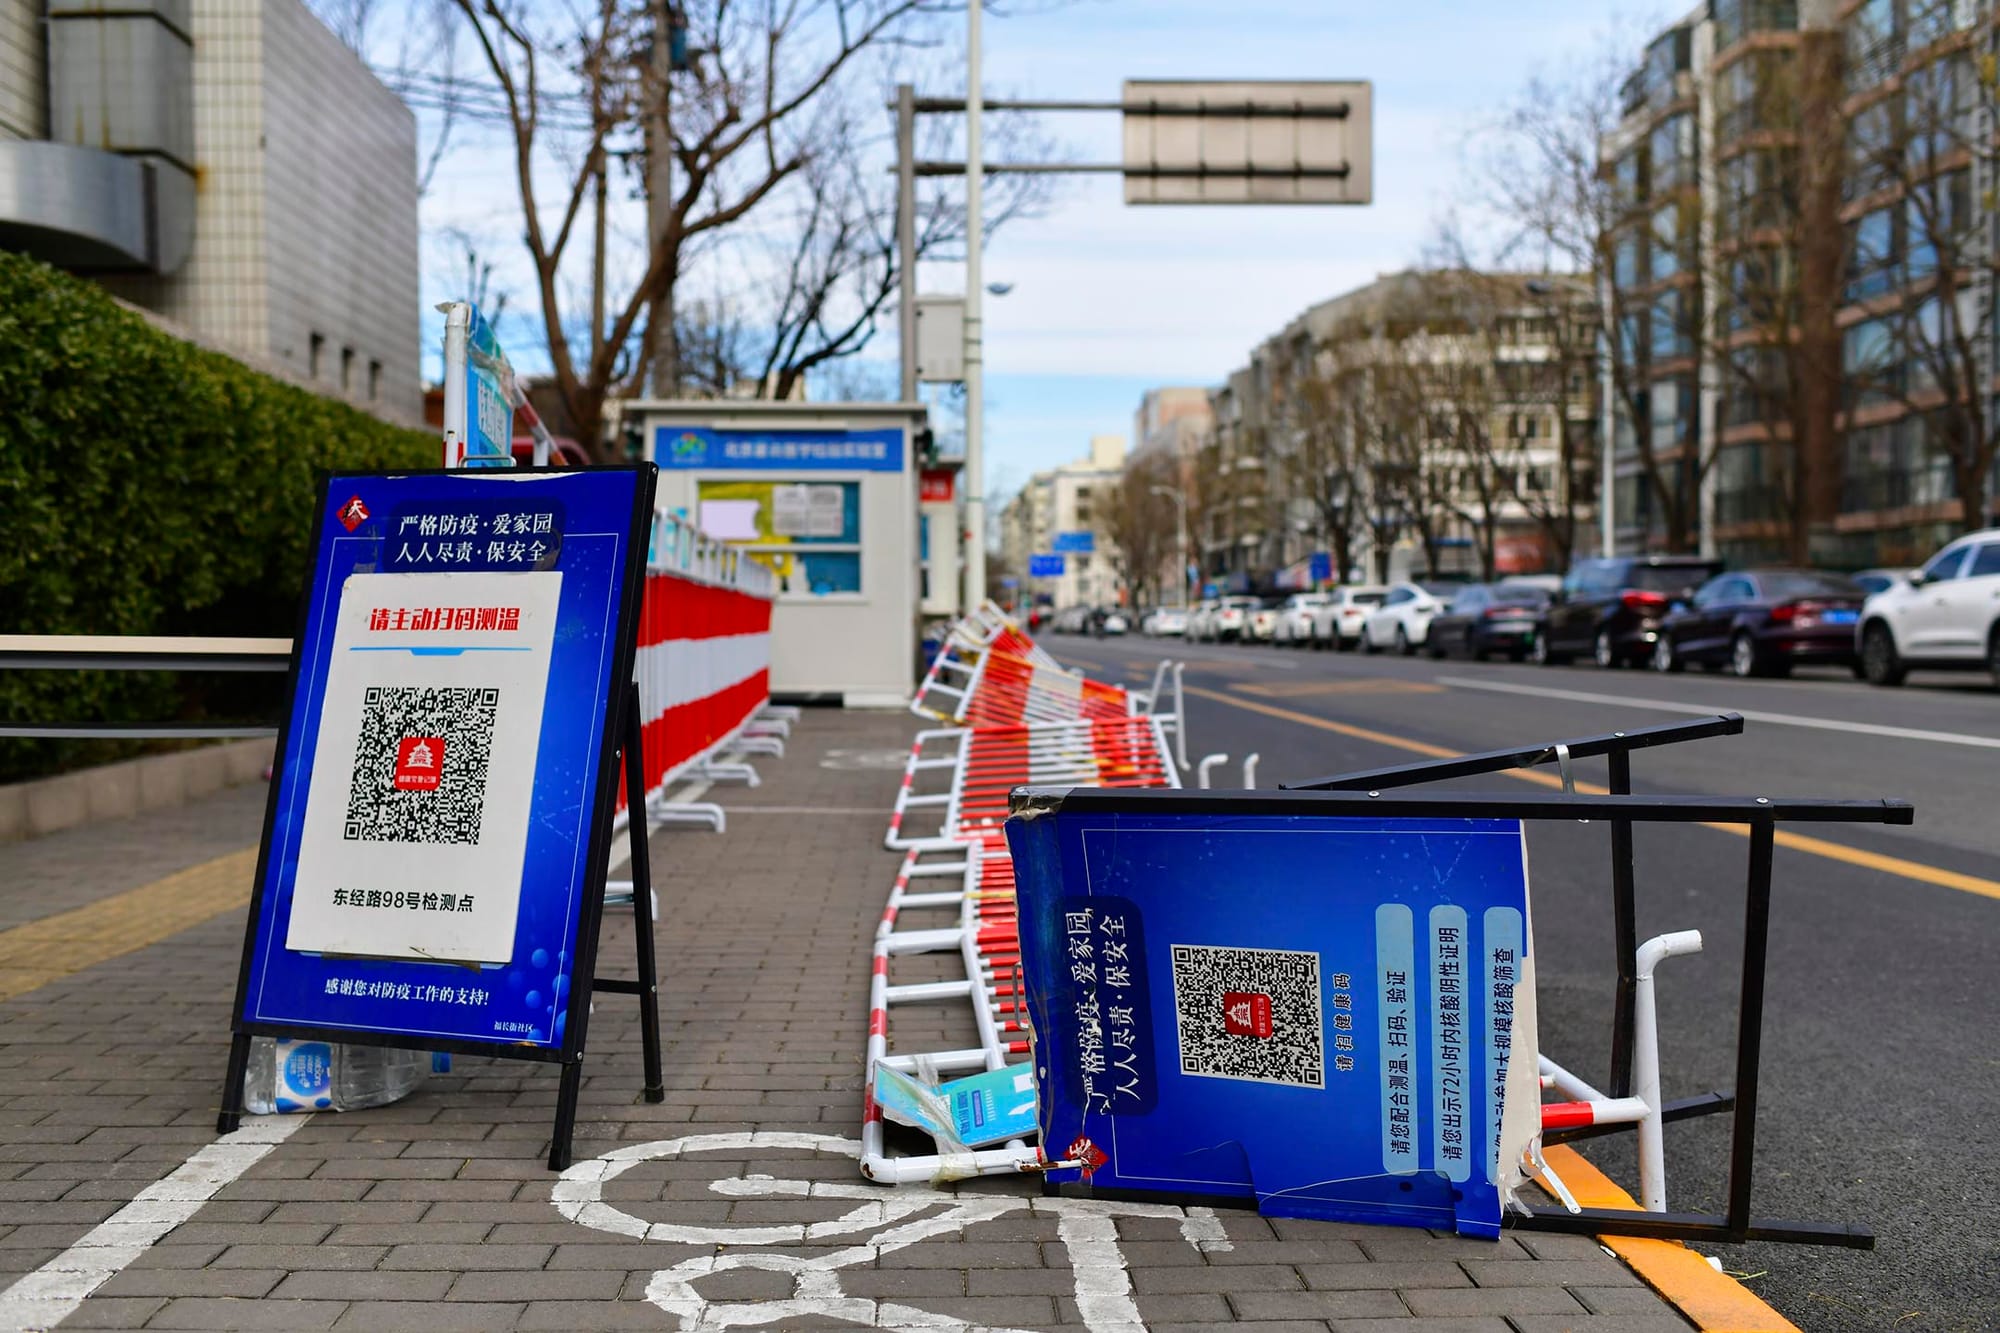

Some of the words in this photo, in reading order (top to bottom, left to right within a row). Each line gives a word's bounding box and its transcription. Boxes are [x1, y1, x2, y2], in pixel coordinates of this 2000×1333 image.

[395, 540, 547, 564] 人人尽责·保安全
[398, 513, 553, 536] 严格防疫·爱家园
[369, 607, 521, 631] 请主动扫码测温
[332, 888, 475, 912] 东经路98号检测点
[1065, 911, 1108, 1098] 严格防疫·爱家园
[1098, 914, 1142, 1101] 人人尽责·保安全
[1332, 972, 1354, 1072] 请扫健康码
[1438, 926, 1463, 1161] 请您出示72小时内核酸阴性证明
[1386, 969, 1411, 1156] 请您配合测温、扫码、验证
